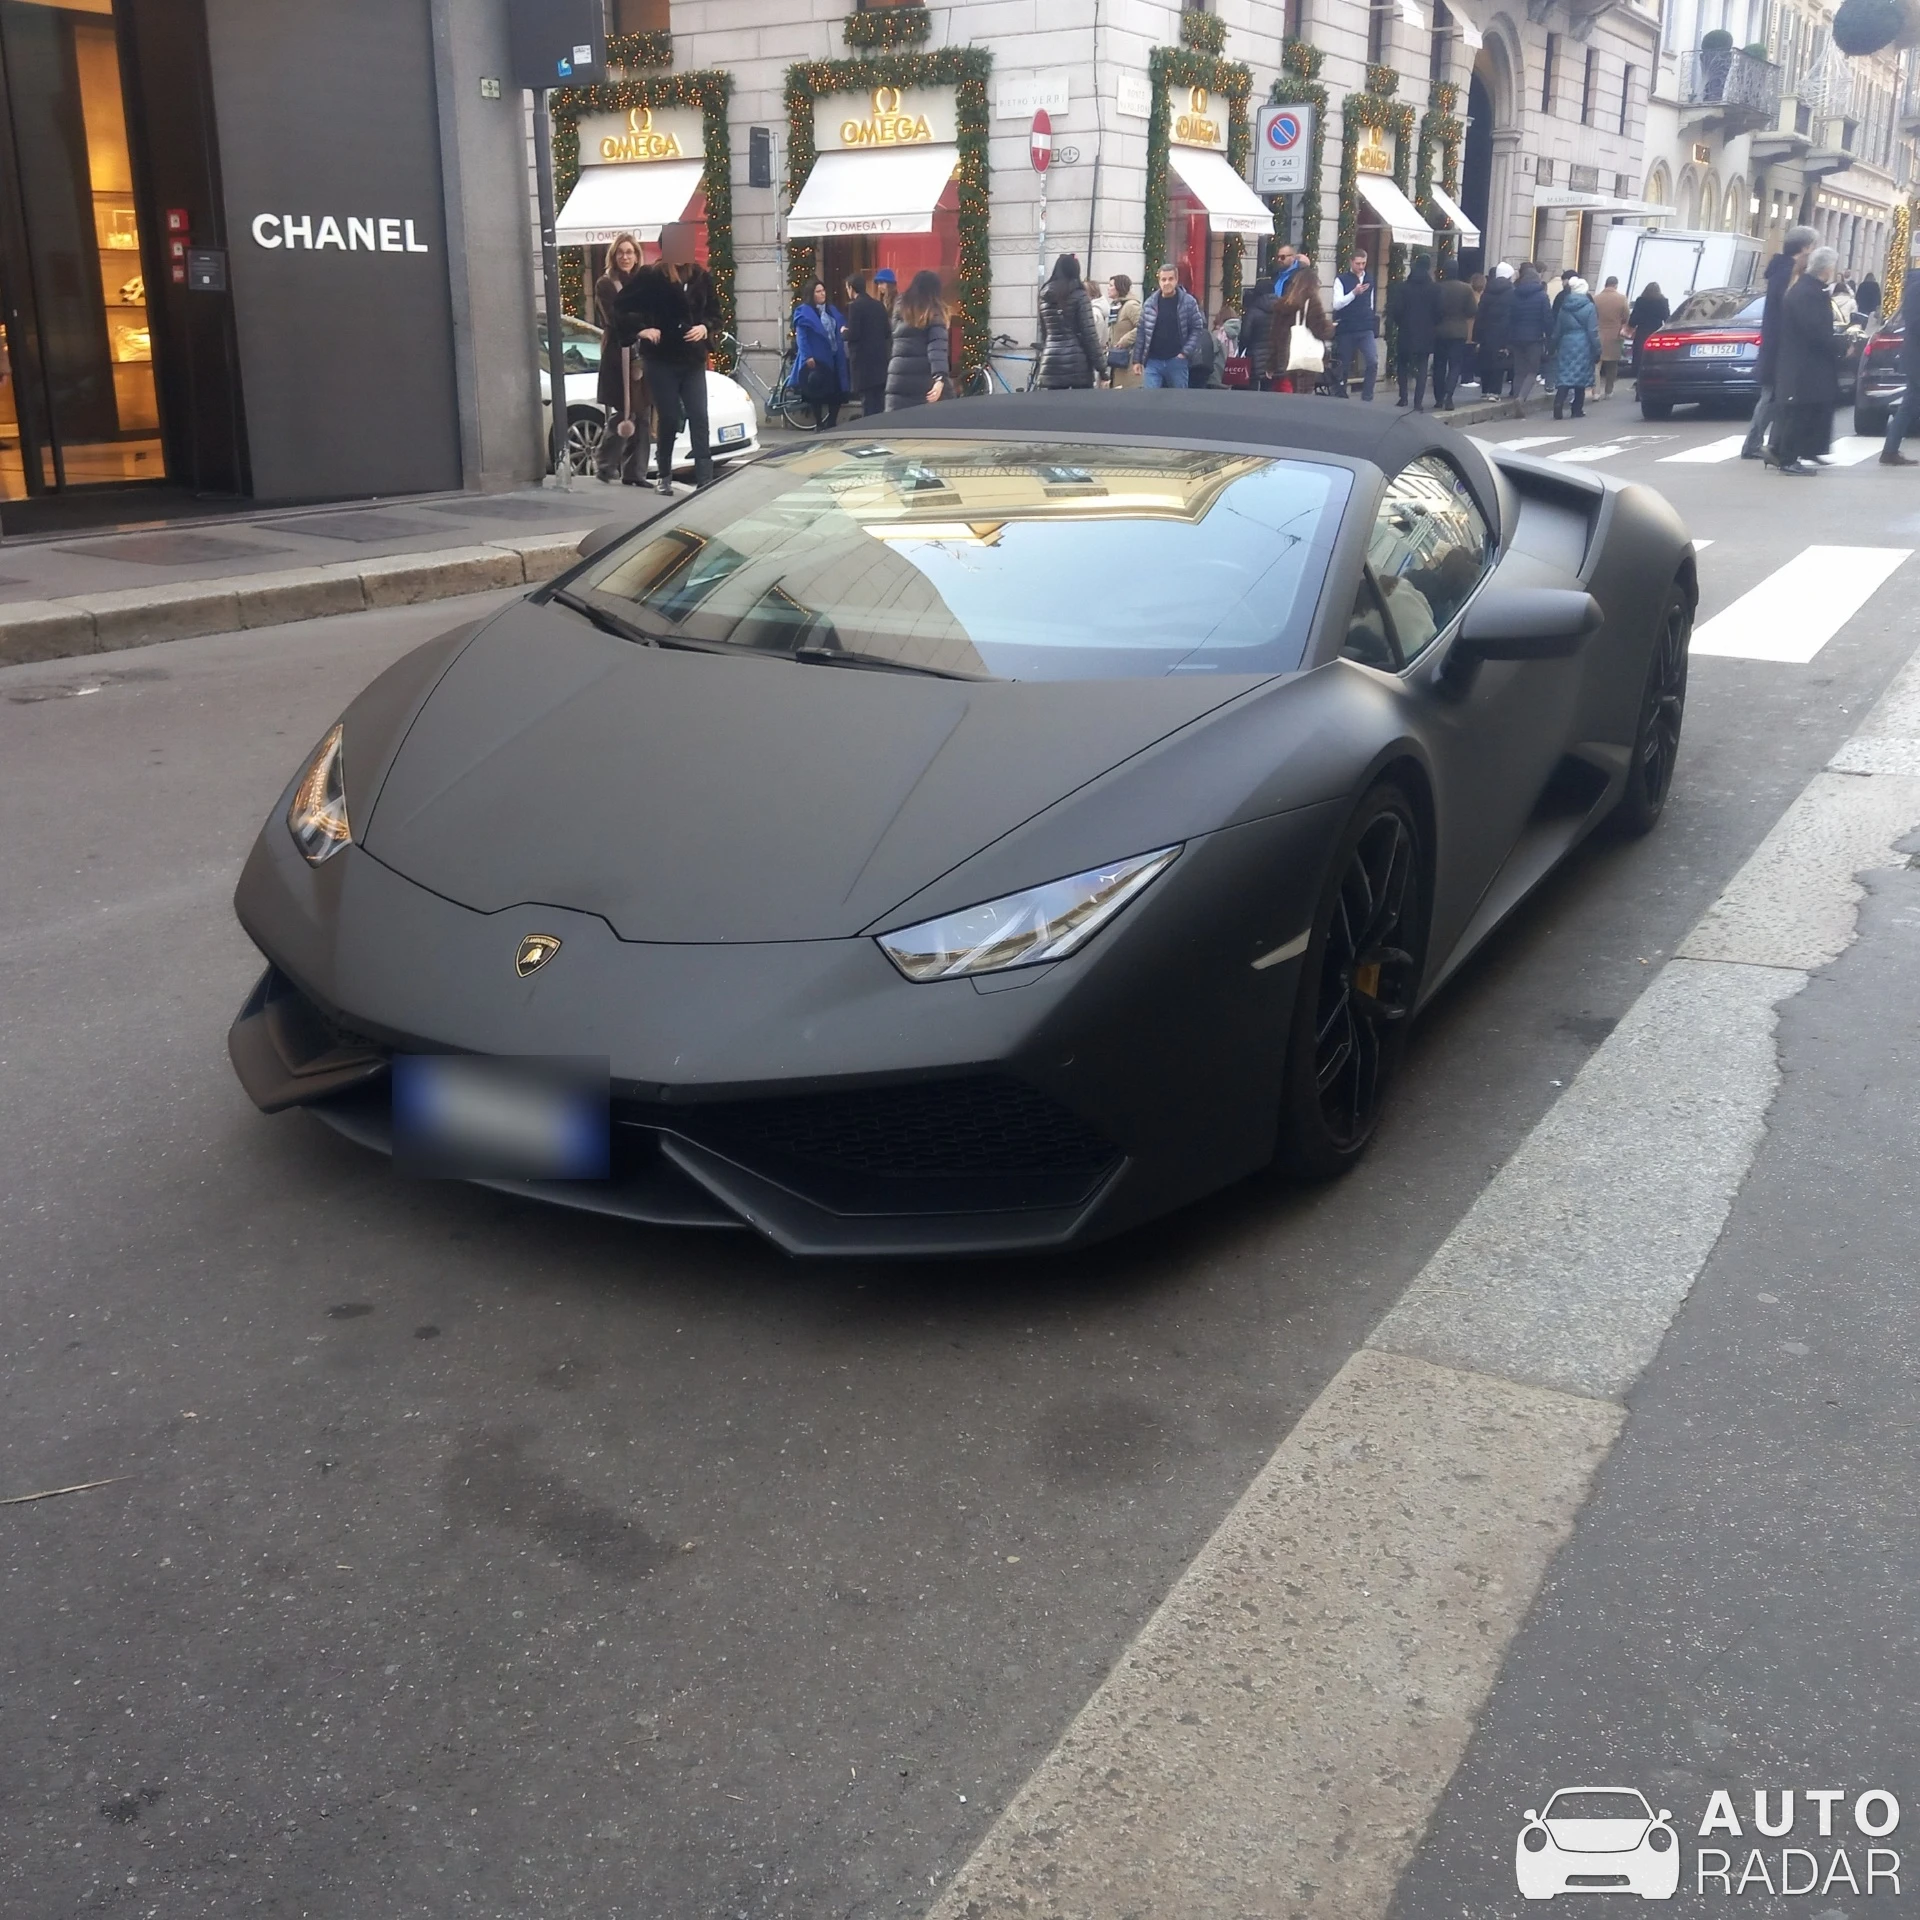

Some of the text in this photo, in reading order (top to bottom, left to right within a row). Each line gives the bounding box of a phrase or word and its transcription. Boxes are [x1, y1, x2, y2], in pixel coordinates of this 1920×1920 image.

[840, 114, 935, 145] OMEGA
[600, 132, 683, 161] OMEGA
[251, 213, 428, 253] CHANEL
[839, 220, 878, 232] OMEGA
